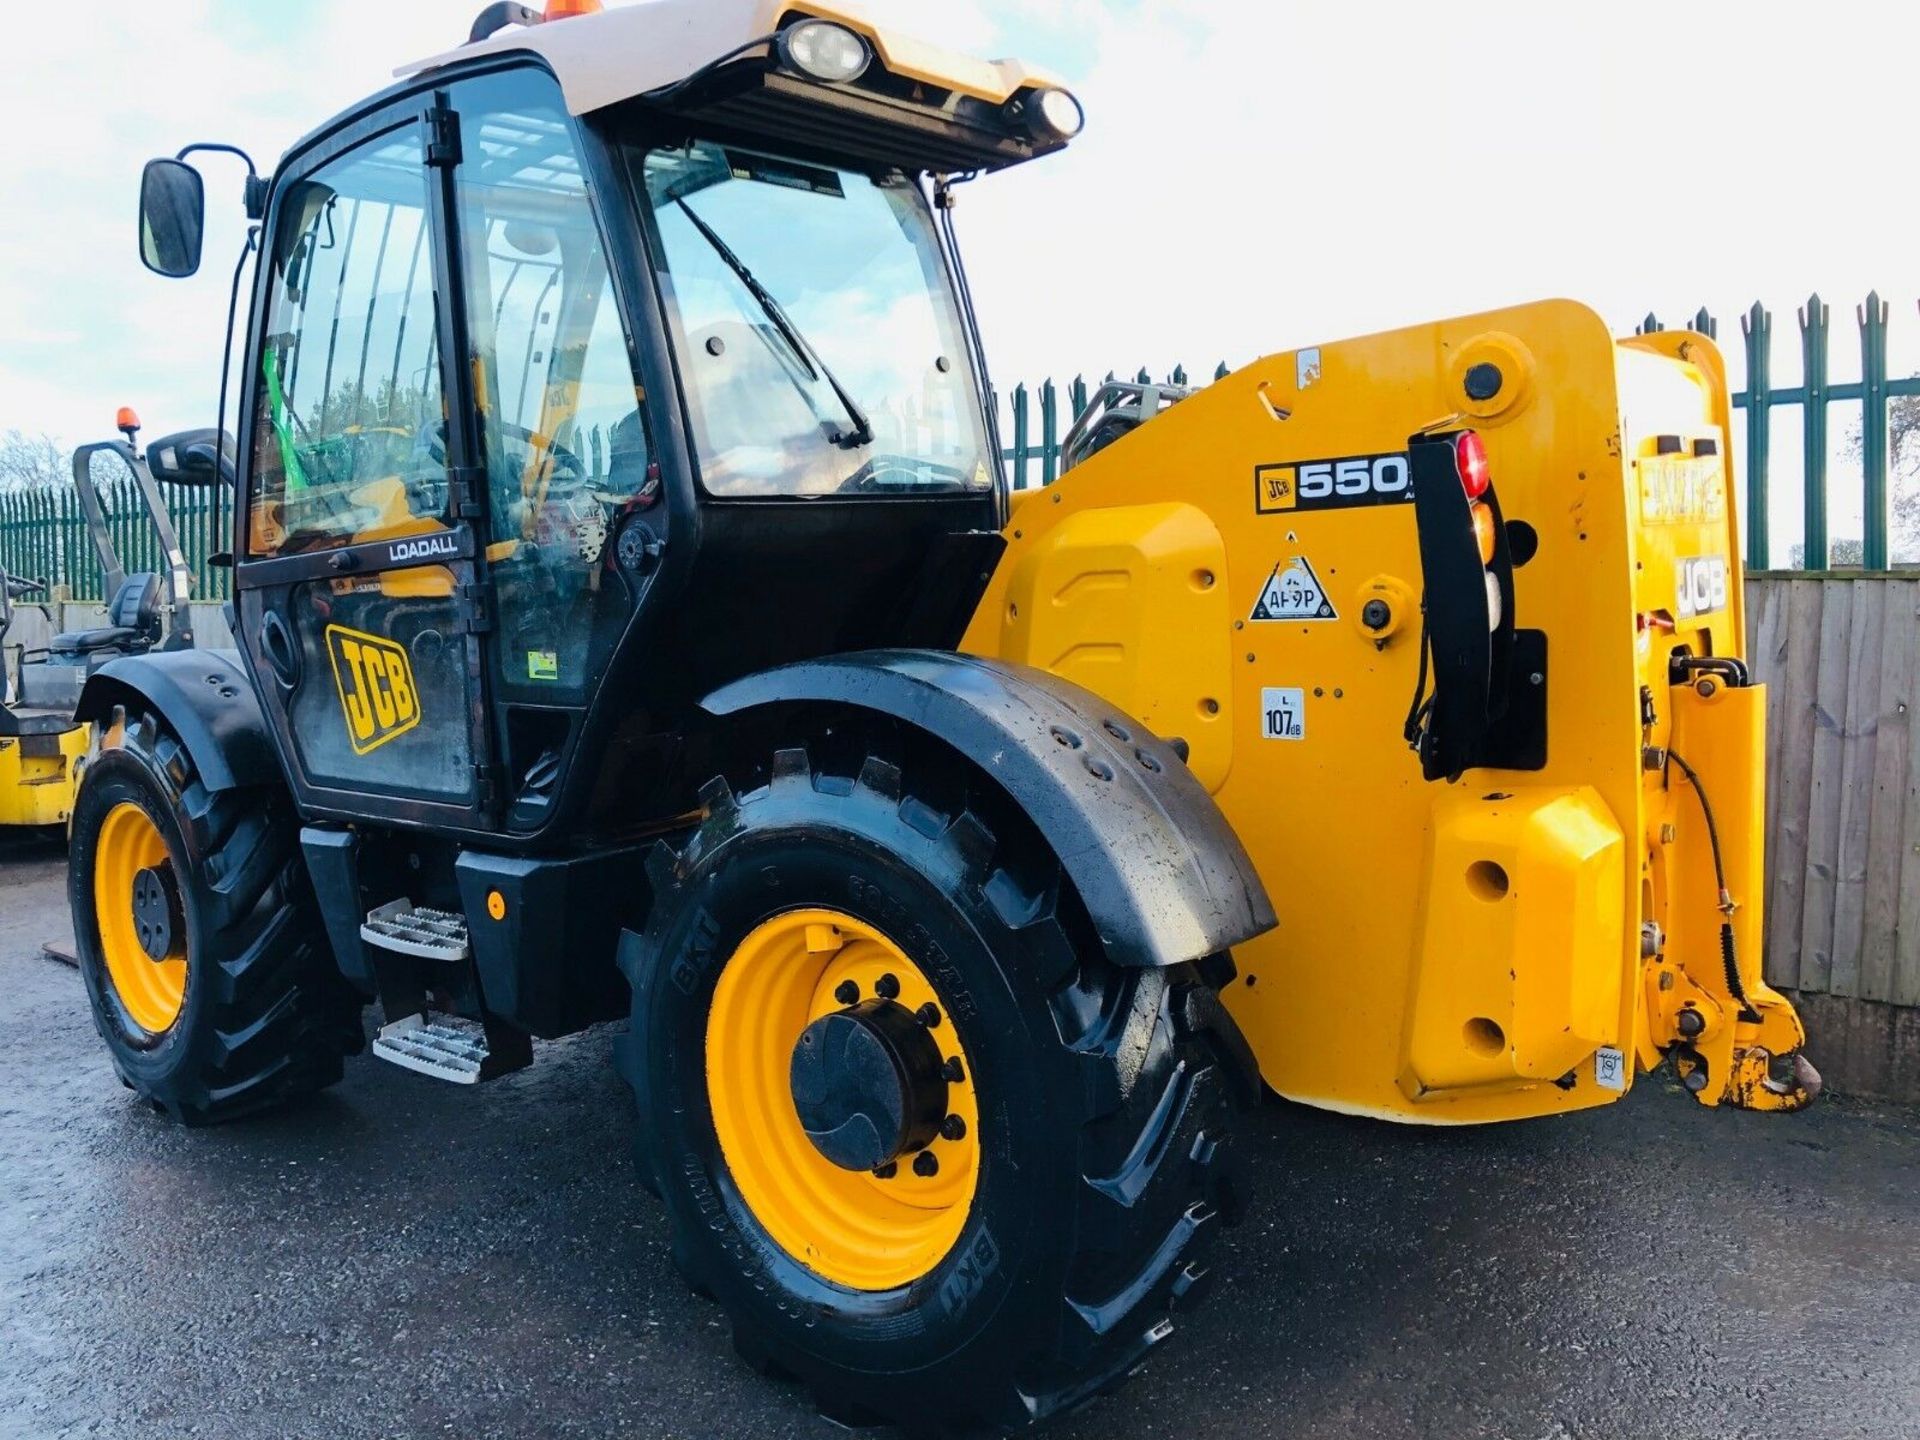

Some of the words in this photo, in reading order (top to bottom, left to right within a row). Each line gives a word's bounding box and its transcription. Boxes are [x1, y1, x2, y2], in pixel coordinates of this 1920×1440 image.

[1269, 480, 1290, 498] JCB
[389, 536, 458, 561] LOADALL
[1677, 559, 1727, 613] JCB
[341, 639, 415, 741] JCB
[1282, 696, 1289, 705] L
[671, 906, 721, 994] BKT
[940, 1223, 1000, 1317] BKT
